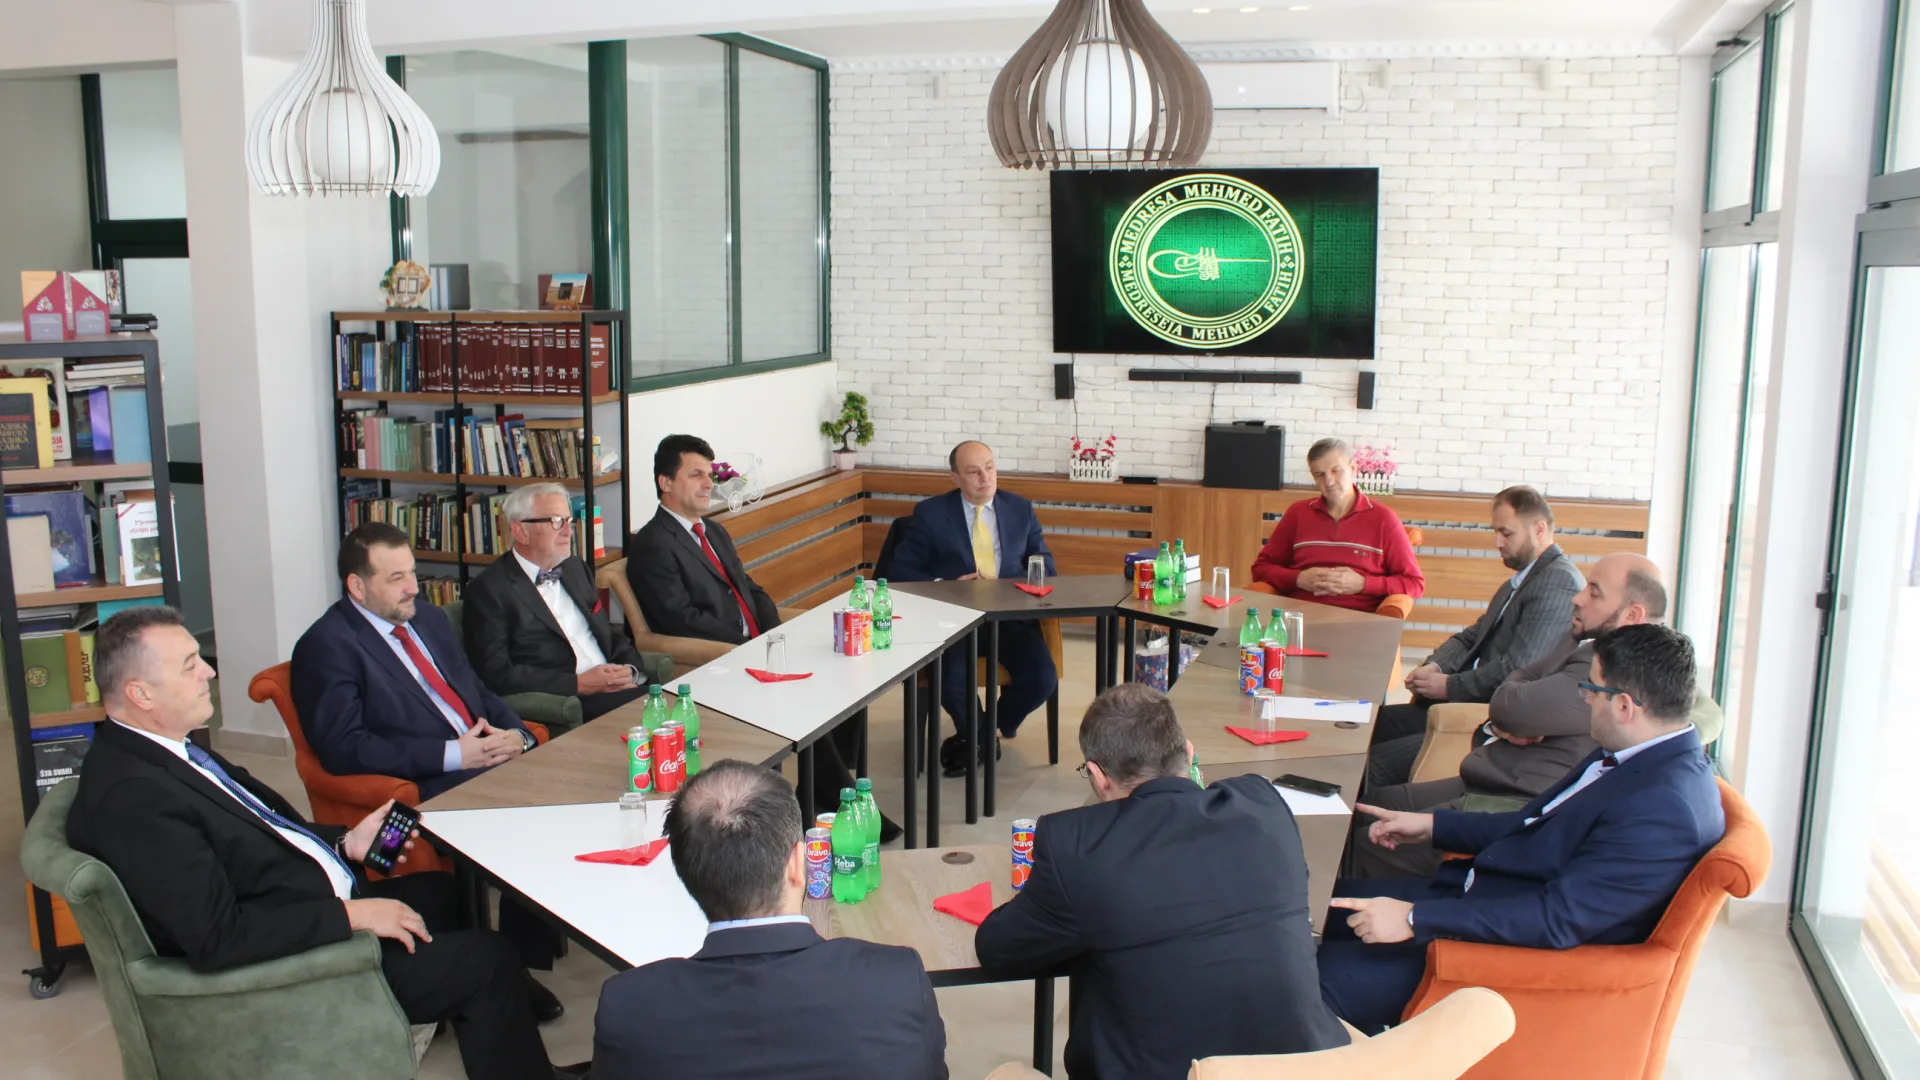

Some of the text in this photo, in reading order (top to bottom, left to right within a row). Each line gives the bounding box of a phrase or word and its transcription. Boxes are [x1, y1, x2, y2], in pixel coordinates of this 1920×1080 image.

[1120, 183, 1294, 256] MEDRESA MEHMED FATIH
[1120, 269, 1293, 341] MEDRESEJA MEHMED FATIH
[1013, 838, 1034, 847] bravo
[807, 848, 828, 857] bravo
[834, 856, 856, 868] Heba
